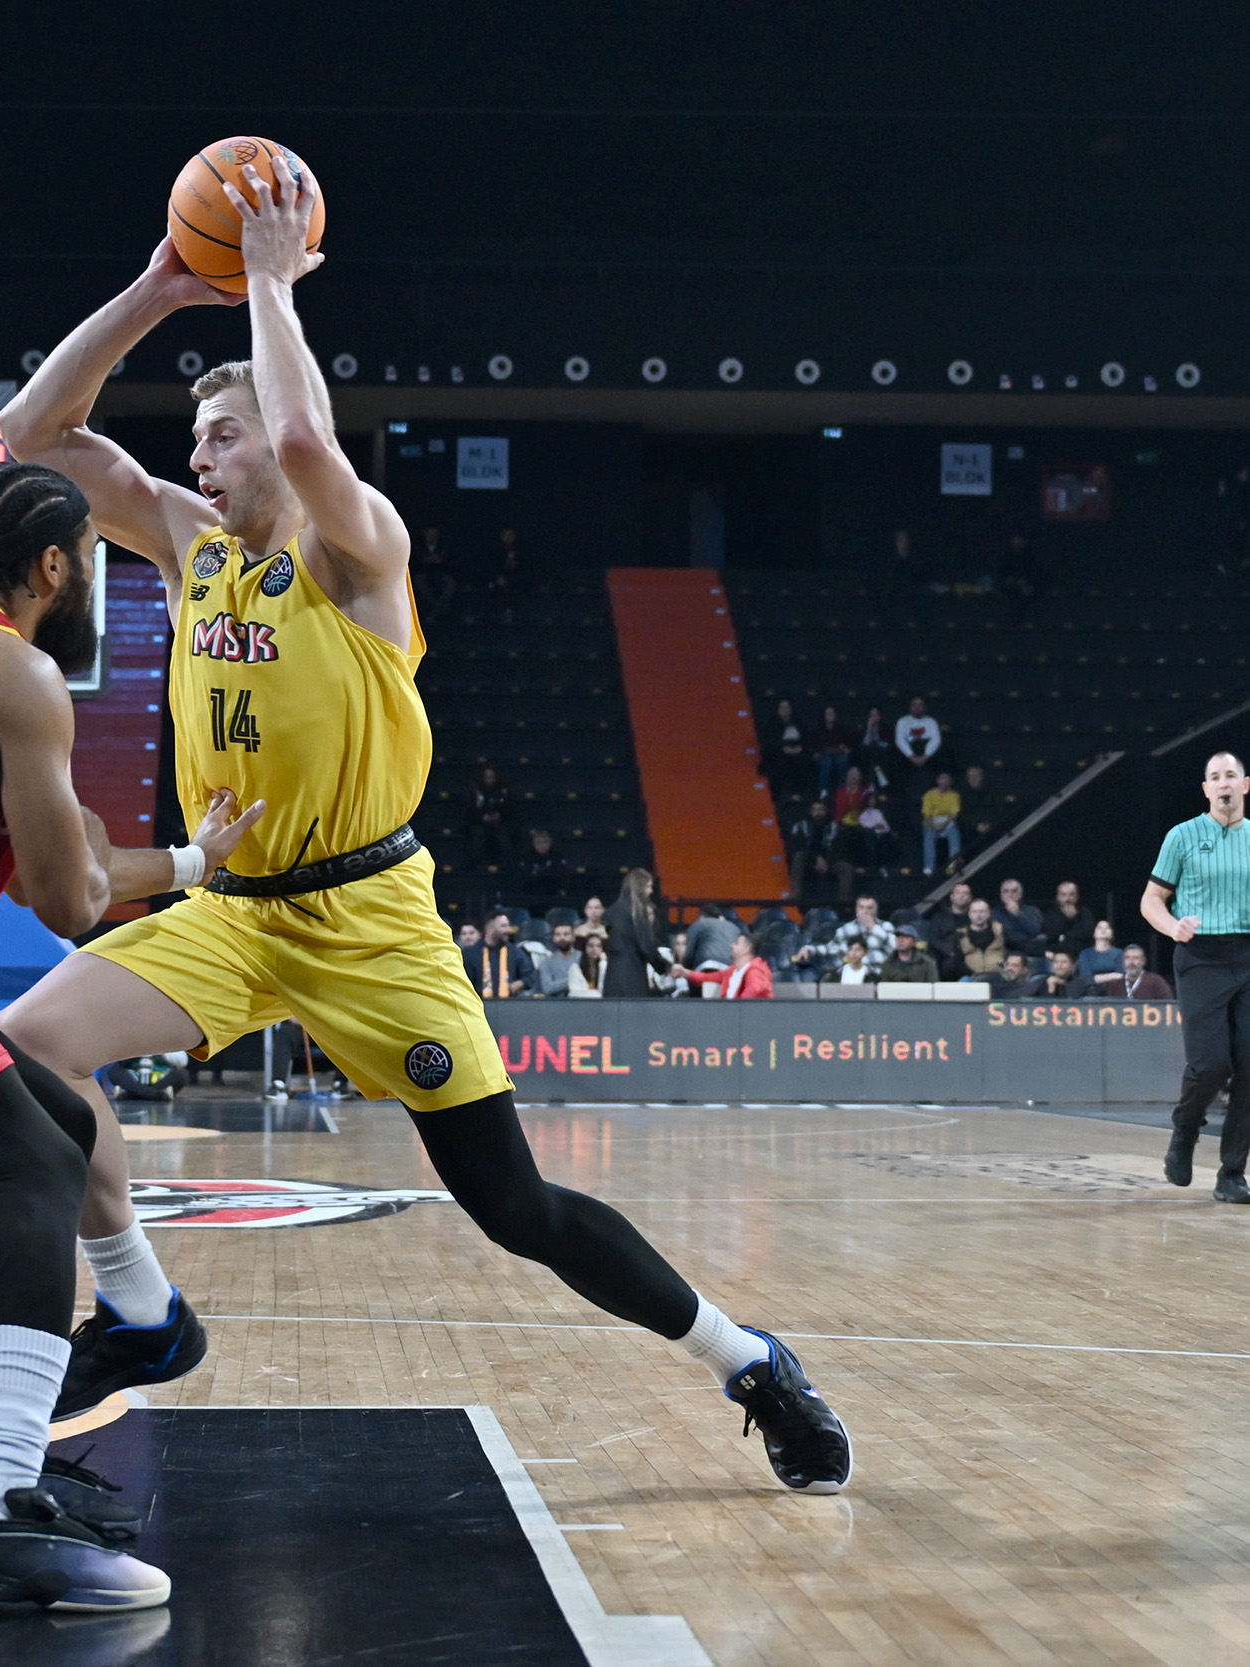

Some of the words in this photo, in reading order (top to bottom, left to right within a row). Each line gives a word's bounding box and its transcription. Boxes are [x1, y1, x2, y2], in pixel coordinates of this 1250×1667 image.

[192, 611, 279, 663] MSK
[210, 687, 261, 753] 14
[499, 1034, 631, 1074] UNEL
[648, 1040, 754, 1068] Smart
[793, 1033, 949, 1061] Resilient
